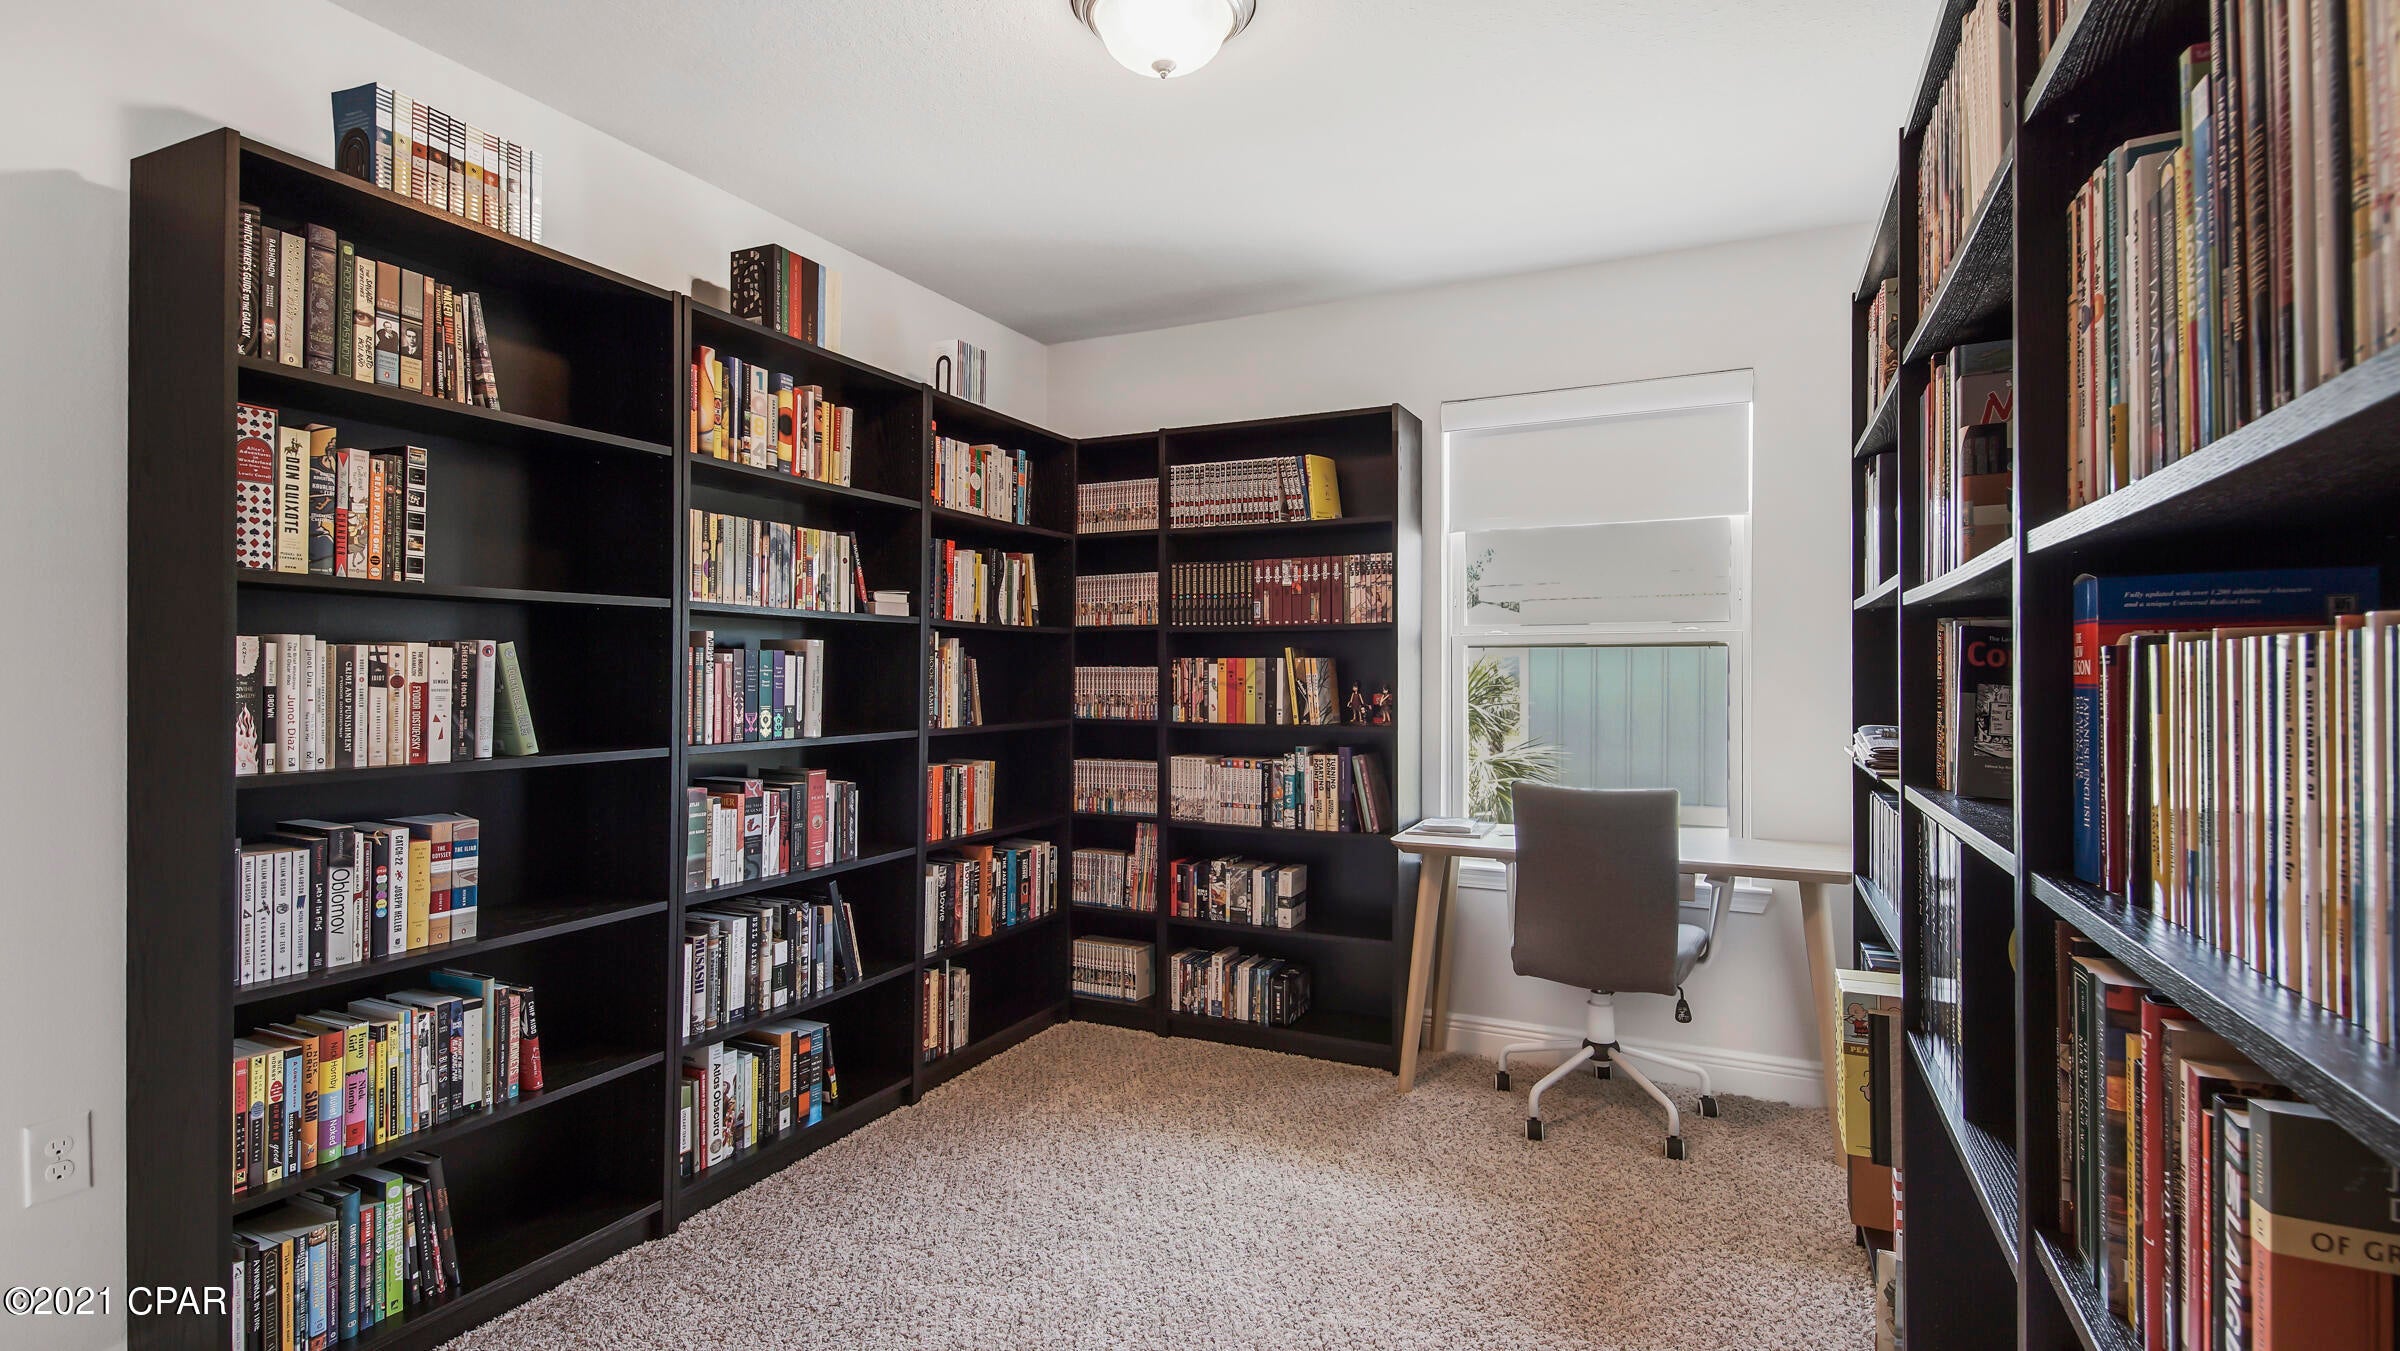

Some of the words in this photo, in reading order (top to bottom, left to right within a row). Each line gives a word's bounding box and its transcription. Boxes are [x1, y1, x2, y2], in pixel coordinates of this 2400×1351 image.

[2218, 96, 2226, 141] JAPAN
[2229, 111, 2237, 134] Art
[2219, 144, 2227, 188] ATLAS
[2183, 147, 2193, 218] KANJI
[2229, 156, 2240, 223] Japanese
[2185, 224, 2196, 318] POWER
[2231, 226, 2244, 342] Swordsmanship
[443, 289, 452, 317] NAKED
[242, 312, 250, 338] GALAXY
[444, 317, 454, 344] LUNCH
[365, 335, 373, 369] ROBERTO
[238, 458, 272, 466] Wonderland
[285, 457, 300, 479] DON
[373, 475, 382, 497] READY
[284, 484, 299, 535] QUIXOTE
[373, 499, 381, 535] PLAYER
[372, 537, 380, 554] ONE
[344, 661, 353, 685] CRIME
[461, 645, 469, 679] SHERLOCK
[344, 687, 352, 703] AND
[411, 686, 422, 709] FYODOR
[460, 682, 468, 707] HOLMES
[2285, 658, 2293, 722] Japanese
[267, 694, 275, 718] DROWN
[344, 706, 352, 752] PUNISHMENT
[411, 711, 421, 749] DOSTOEVSKY
[2306, 690, 2315, 777] DICTIONARY
[2285, 727, 2294, 792] Sentence
[2307, 784, 2315, 801] OF
[2285, 796, 2294, 856] Patterns
[395, 835, 404, 866] CATCH-22
[432, 851, 452, 859] ODYSSEY
[2286, 861, 2295, 883] for
[331, 869, 350, 935] Oblomov
[394, 885, 403, 909] JOSEPH
[394, 911, 403, 933] HELLER
[694, 939, 705, 994] MUSASHI
[511, 1017, 519, 1040] CHEESE
[529, 1018, 537, 1035] KIDD
[348, 1034, 357, 1053] Girl
[358, 1031, 366, 1059] Funny
[305, 1044, 313, 1085] HORNBY
[510, 1042, 519, 1076] MONKEYS
[328, 1061, 339, 1089] Hornby
[713, 1063, 721, 1089] Atlas
[347, 1082, 357, 1114] Hornby
[357, 1079, 366, 1101] Nick
[304, 1091, 317, 1122] SLAM
[713, 1091, 721, 1136] Obscura
[273, 1121, 279, 1129] TO
[328, 1120, 338, 1146] Naked
[269, 1144, 282, 1164] good
[395, 1200, 403, 1220] THE
[386, 1203, 394, 1250] PROBLEM
[421, 1226, 426, 1234] IN
[394, 1222, 403, 1281] THREE-BODY
[2311, 1232, 2351, 1255] OF
[2364, 1241, 2400, 1264] GR
[254, 1302, 260, 1311] IN
